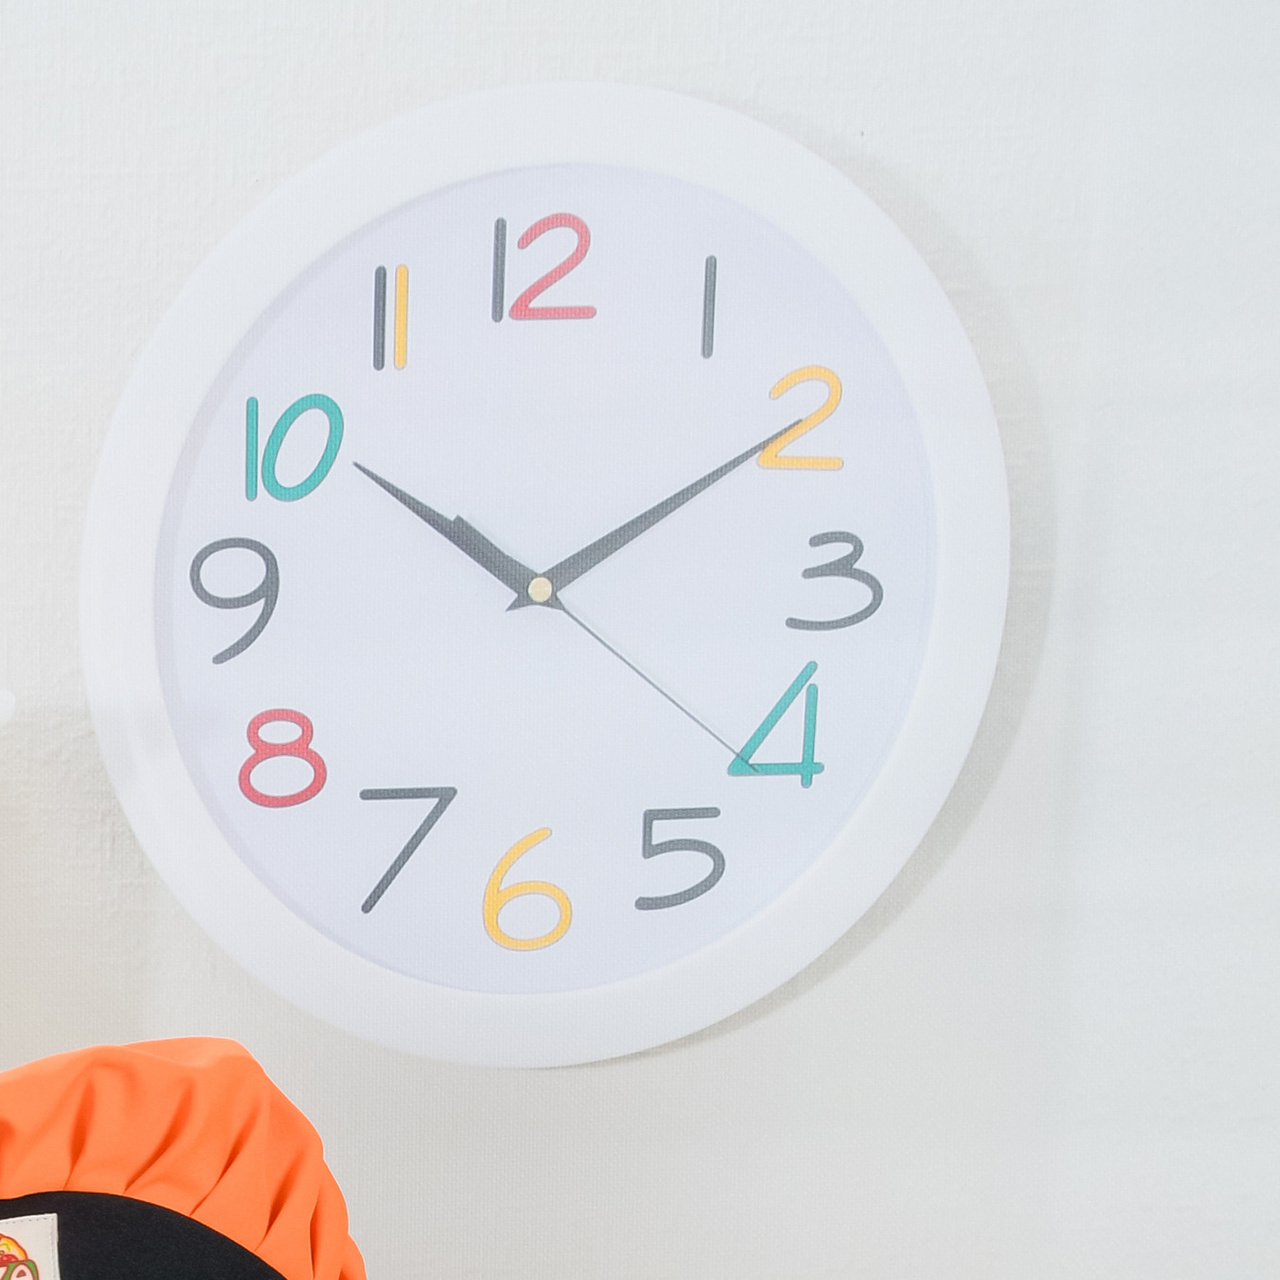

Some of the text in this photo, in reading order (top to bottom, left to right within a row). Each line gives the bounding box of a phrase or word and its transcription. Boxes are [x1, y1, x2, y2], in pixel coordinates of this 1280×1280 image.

[372, 264, 410, 371] 11
[491, 212, 597, 323] 12
[699, 255, 717, 359] 1
[246, 393, 345, 503] 10
[756, 364, 844, 470] 2
[188, 536, 281, 664] 9
[784, 530, 884, 631] 3
[237, 707, 328, 809] 8
[726, 660, 825, 788] 4
[358, 785, 458, 915] 7
[481, 826, 573, 953] 6
[634, 806, 726, 911] 5
